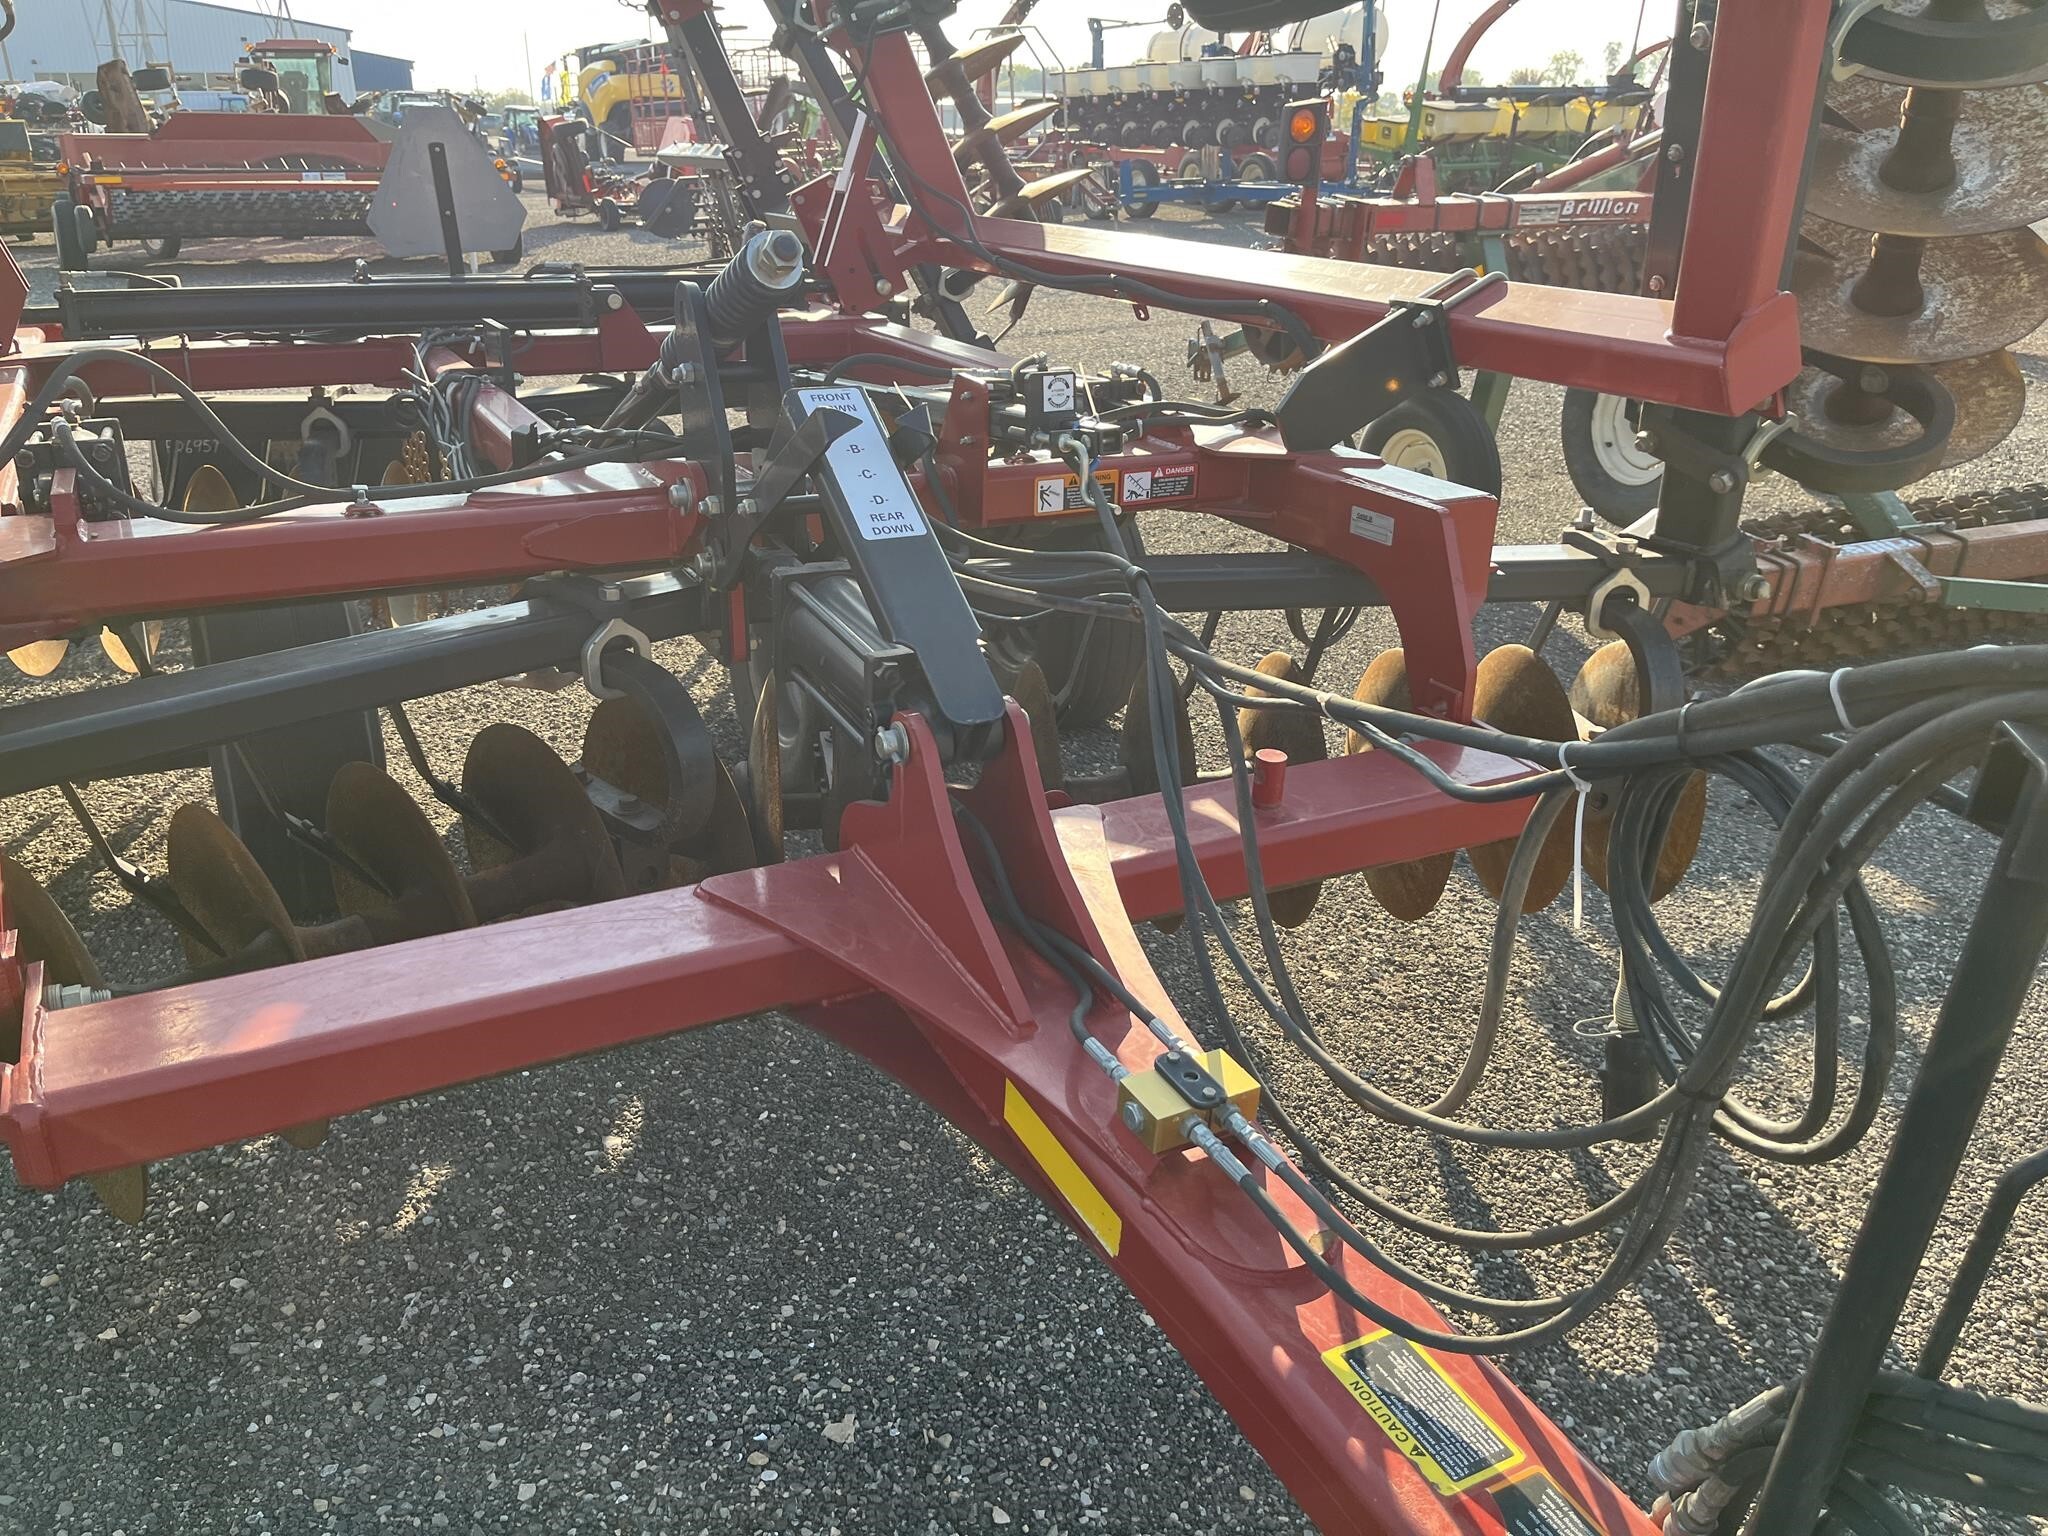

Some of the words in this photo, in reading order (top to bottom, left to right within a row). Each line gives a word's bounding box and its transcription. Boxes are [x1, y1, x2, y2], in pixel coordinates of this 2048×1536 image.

[810, 392, 851, 402] FRONT
[1166, 466, 1194, 474] DANGER
[870, 512, 905, 522] REAR
[872, 524, 914, 535] DOWN
[1380, 1394, 1391, 1404] and
[1348, 1380, 1409, 1442] CAUTION
[1439, 1460, 1459, 1479] Failure
